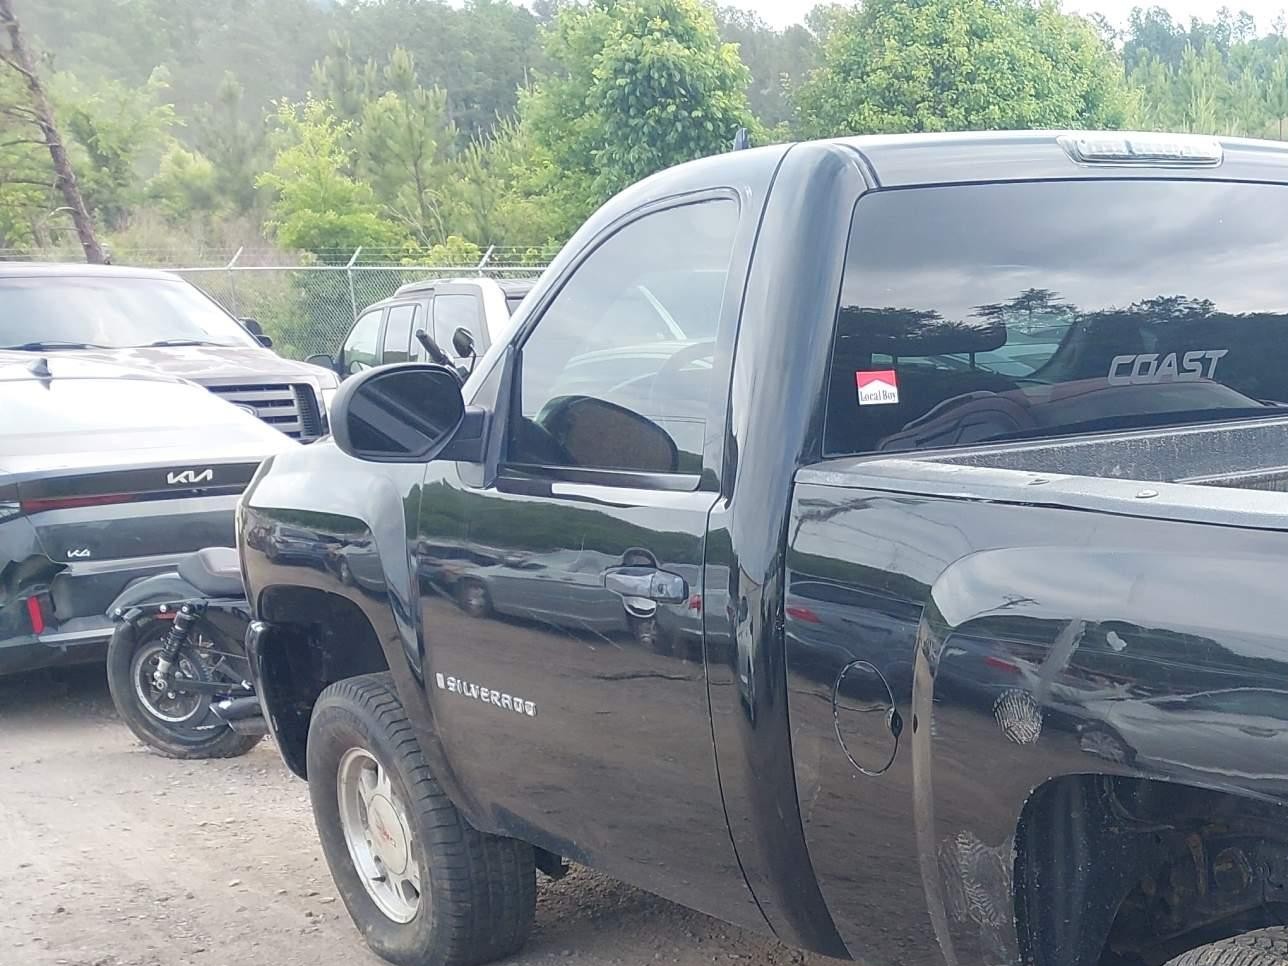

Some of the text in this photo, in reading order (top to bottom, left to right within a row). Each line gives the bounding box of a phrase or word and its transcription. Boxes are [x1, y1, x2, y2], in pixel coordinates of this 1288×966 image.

[1107, 349, 1230, 386] COAST
[860, 388, 896, 402] Local Boy
[166, 469, 213, 484] KIA
[66, 548, 91, 558] K4
[446, 676, 537, 717] SILVERADO
